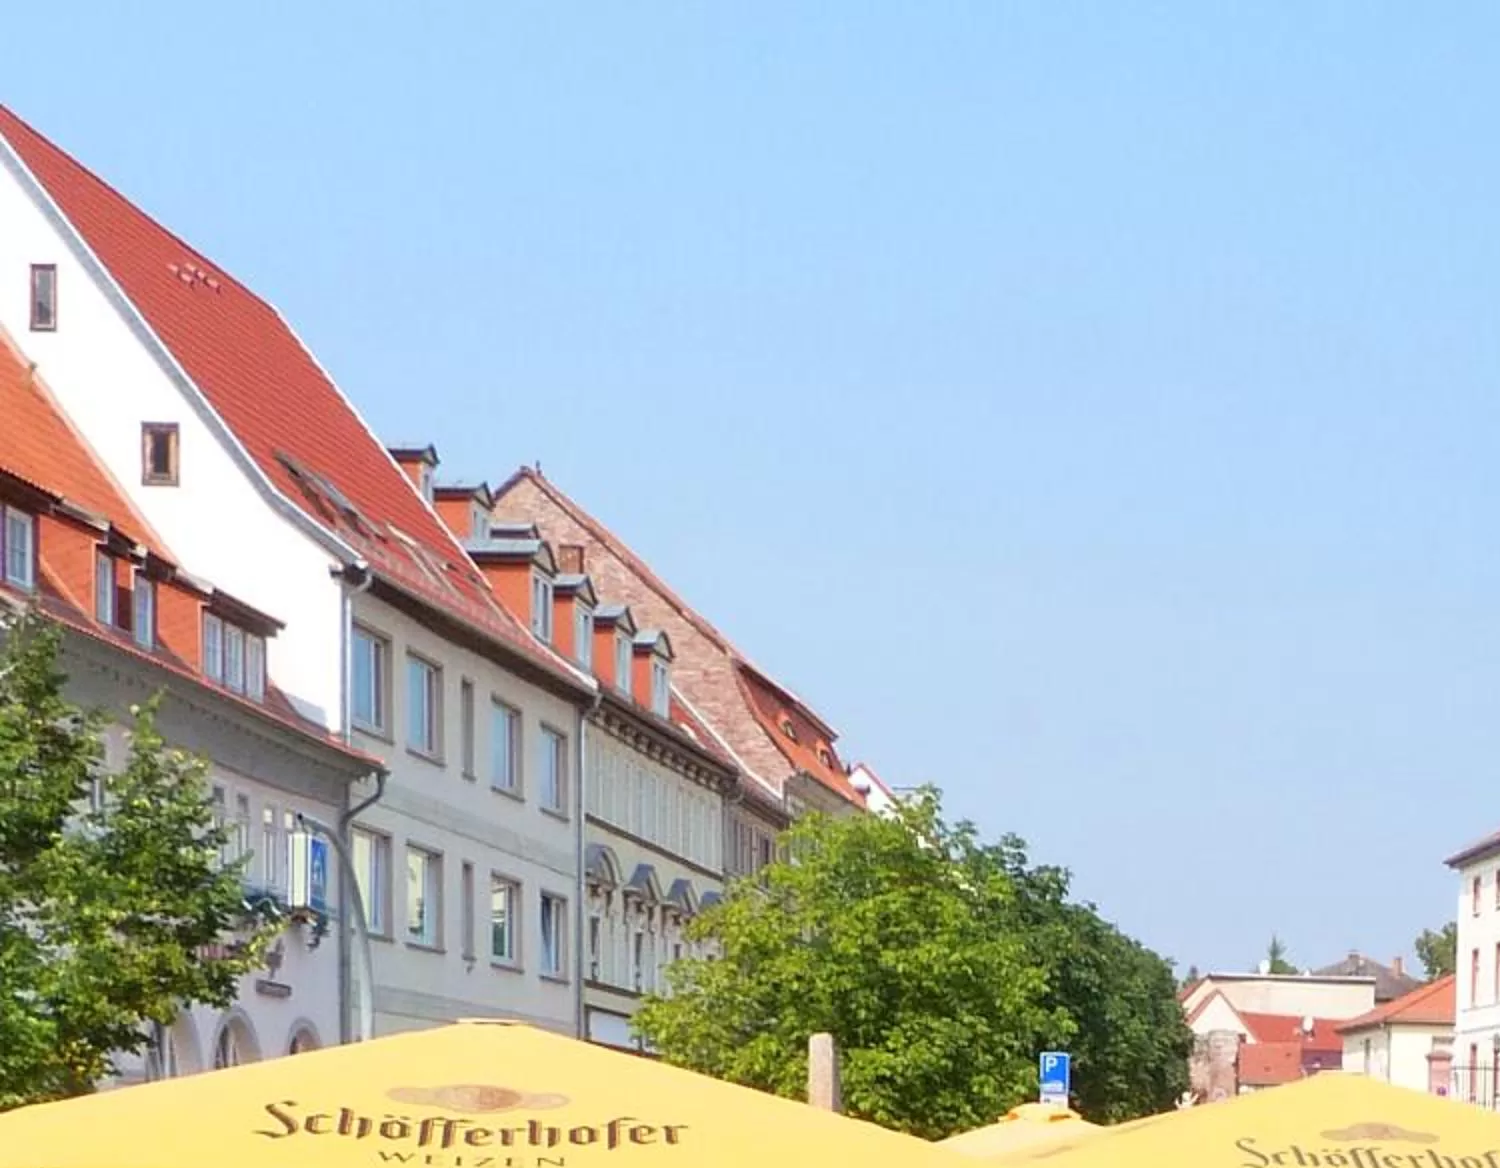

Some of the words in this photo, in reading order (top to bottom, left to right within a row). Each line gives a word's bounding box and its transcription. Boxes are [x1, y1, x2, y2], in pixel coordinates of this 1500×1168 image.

[1045, 1056, 1058, 1072] P
[251, 1100, 689, 1149] Schöfferhofer
[378, 1151, 566, 1168] WEIZEN
